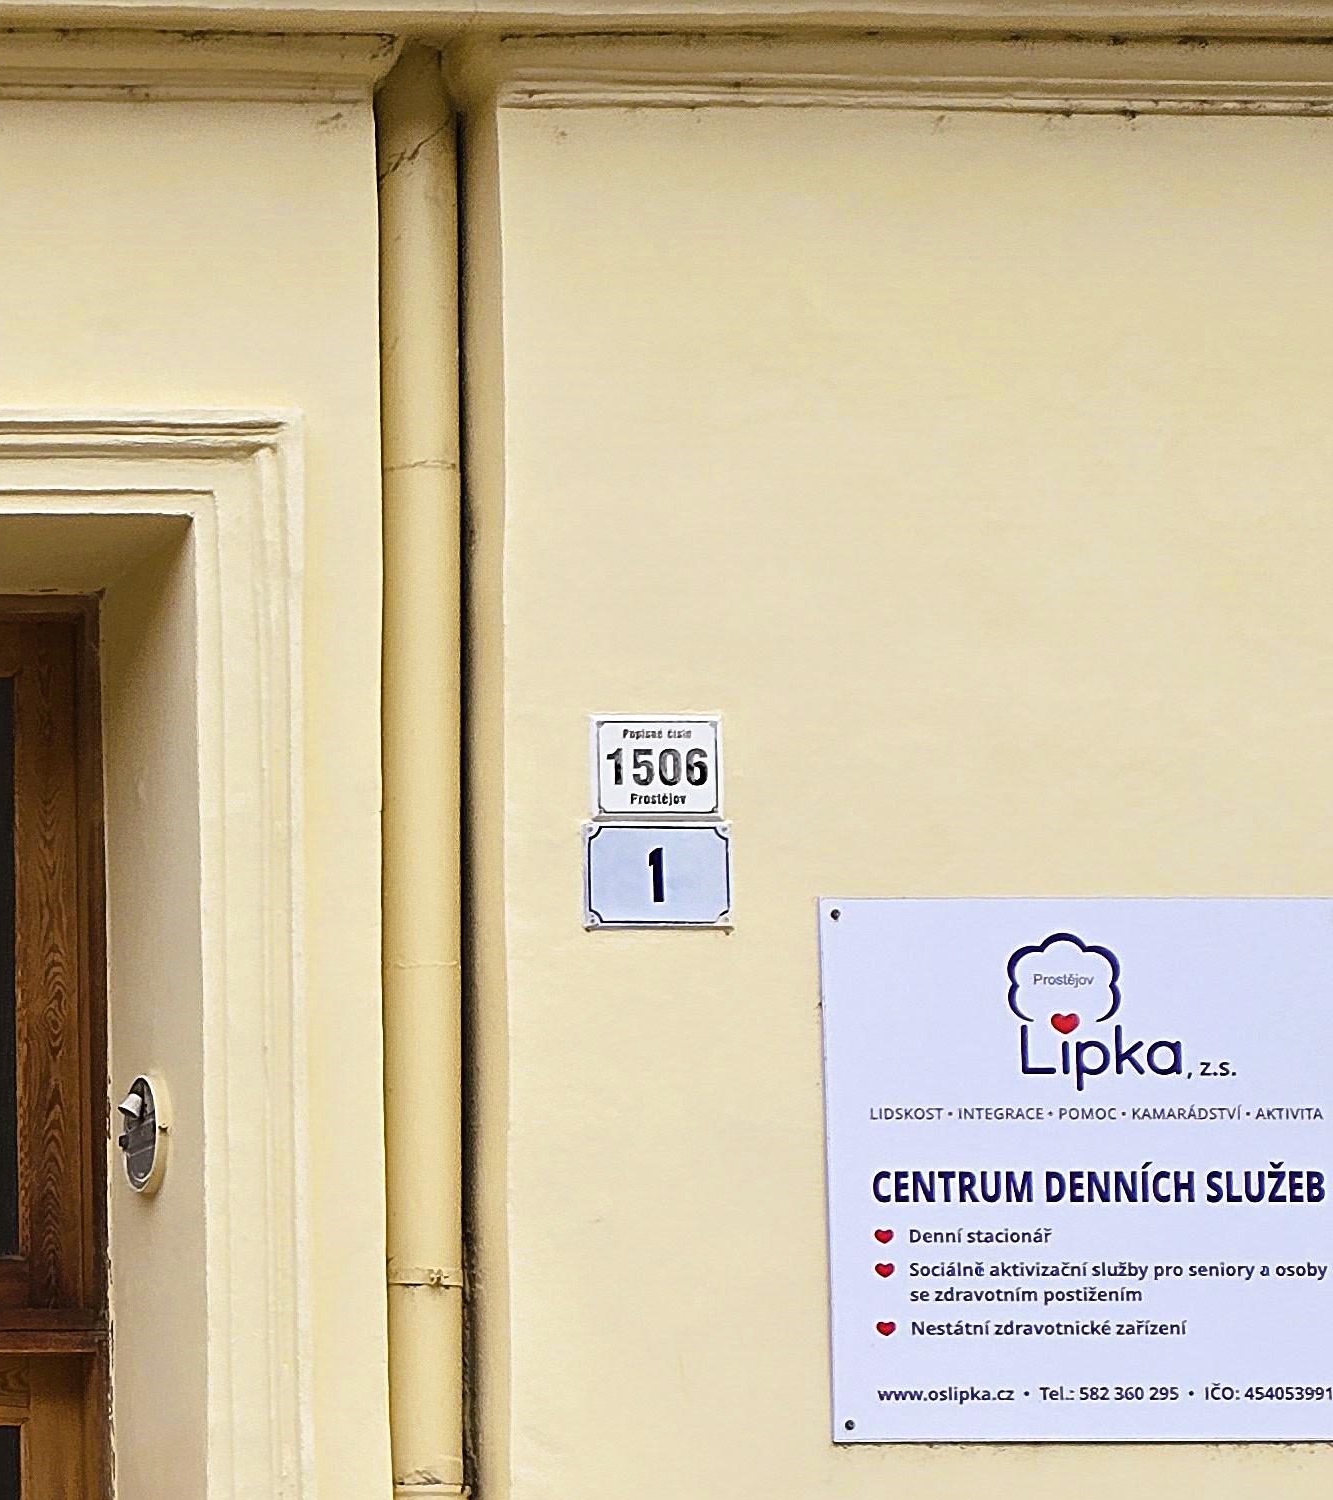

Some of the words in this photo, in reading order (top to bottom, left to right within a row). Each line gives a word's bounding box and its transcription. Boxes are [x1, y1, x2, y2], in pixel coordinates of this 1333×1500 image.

[606, 747, 709, 787] 1506
[648, 847, 665, 903] 1
[1033, 972, 1095, 990] Prostějov
[1199, 1060, 1237, 1077] z.s.
[869, 1107, 944, 1121] LIDSKOST
[957, 1107, 1044, 1121] INTEGRACE
[1058, 1107, 1117, 1121] POMOC
[1131, 1103, 1242, 1121] KAMARÁDSTVÍ
[1254, 1107, 1324, 1121] AKTIVITA
[872, 1170, 1034, 1204] CENTRUM
[1045, 1161, 1196, 1203] DENNÍCH
[1206, 1161, 1326, 1204] SLUŽEB
[909, 1227, 963, 1244] Denní
[966, 1227, 1053, 1244] stacionář
[909, 1261, 985, 1278] Sociálně
[989, 1261, 1089, 1278] aktivizační
[1091, 1261, 1149, 1282] služby
[1153, 1265, 1184, 1281] pro
[1188, 1261, 1256, 1281] seniory
[1259, 1265, 1271, 1277] a
[1275, 1261, 1328, 1281] osoby
[909, 1290, 930, 1302] se
[934, 1286, 1038, 1303] zdravotním
[1043, 1286, 1143, 1307] postižením
[911, 1319, 991, 1336] Nestátní
[994, 1319, 1112, 1336] zdravotnické
[1115, 1319, 1188, 1336] zařízení
[876, 1385, 1016, 1405] www.oslipka.cz
[1038, 1385, 1075, 1401] Tel.:
[1079, 1386, 1111, 1401] 582
[1113, 1386, 1145, 1401] 360
[1148, 1386, 1180, 1401] 295
[1204, 1382, 1241, 1401] IČO:
